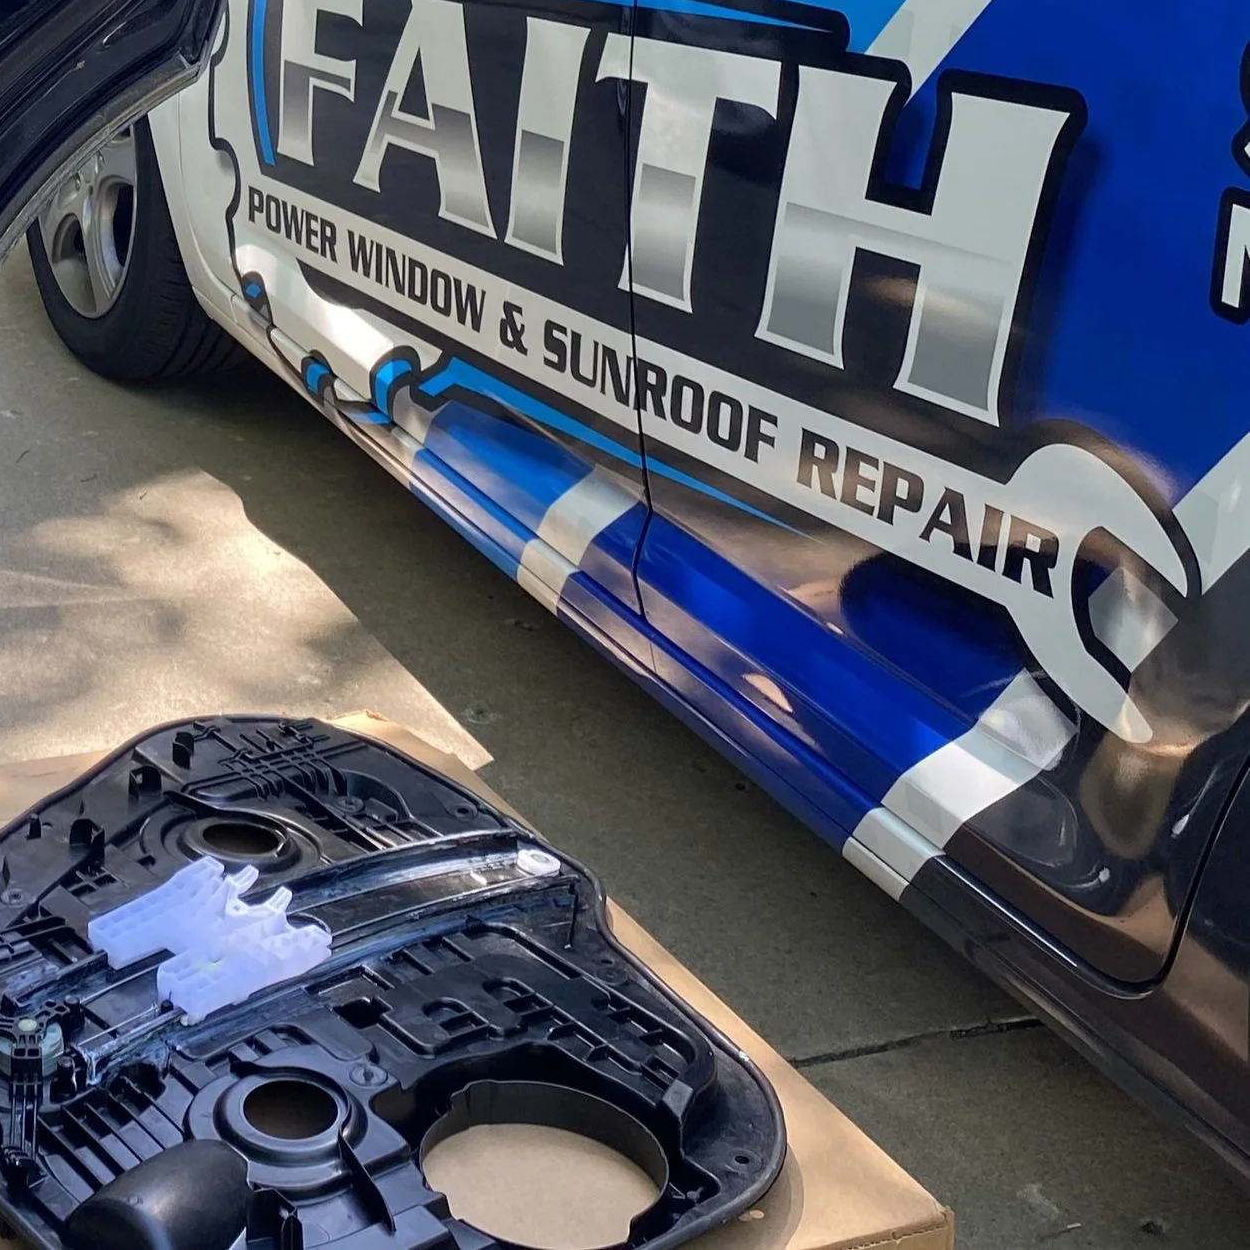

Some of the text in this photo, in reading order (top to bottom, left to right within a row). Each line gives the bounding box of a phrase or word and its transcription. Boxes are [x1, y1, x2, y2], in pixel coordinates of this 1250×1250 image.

[248, 186, 1059, 599] POWER WINDOW & SUNROOF REPAIR
